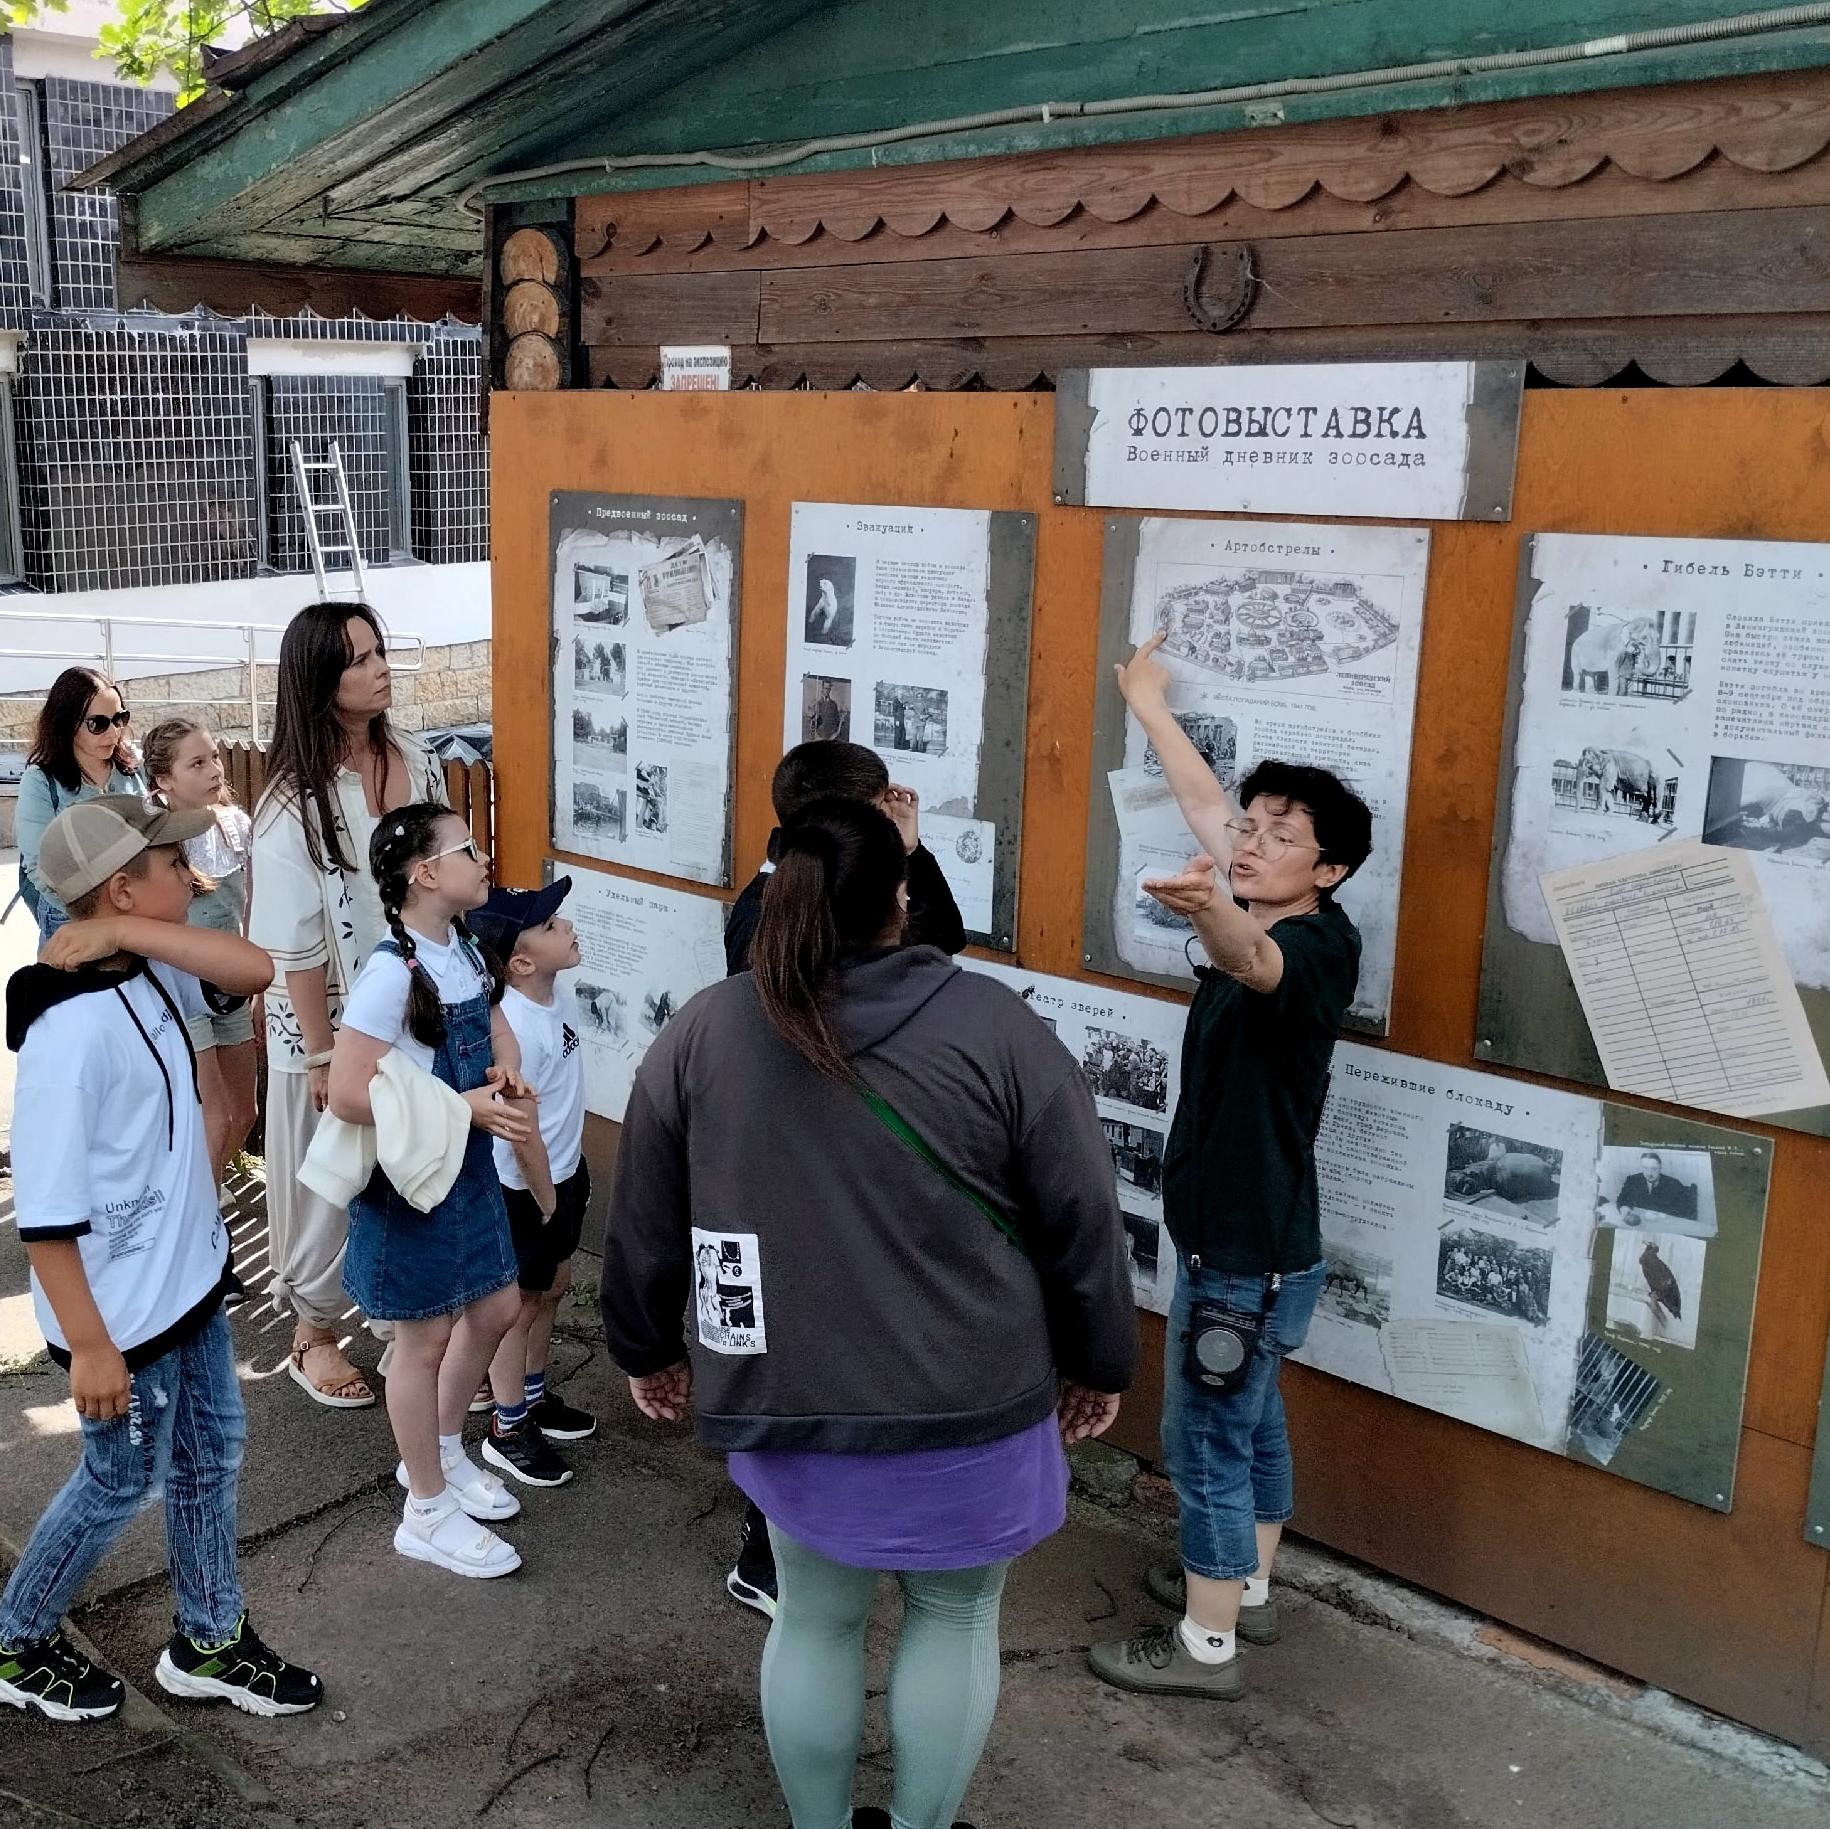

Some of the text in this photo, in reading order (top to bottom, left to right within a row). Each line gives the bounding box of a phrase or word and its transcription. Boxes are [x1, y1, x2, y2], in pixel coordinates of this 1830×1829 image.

[1127, 405, 1428, 440] ФОТОВЫСТАВКА
[1126, 445, 1427, 468] Военный дневник зоосада
[596, 507, 688, 522] Предвоенный зоосад
[1224, 540, 1320, 556] Артобстрелы
[1661, 560, 1803, 580] Гибель Бэтти
[1070, 1001, 1114, 1018] зверей
[1345, 1063, 1515, 1116] Пережившие блокаду
